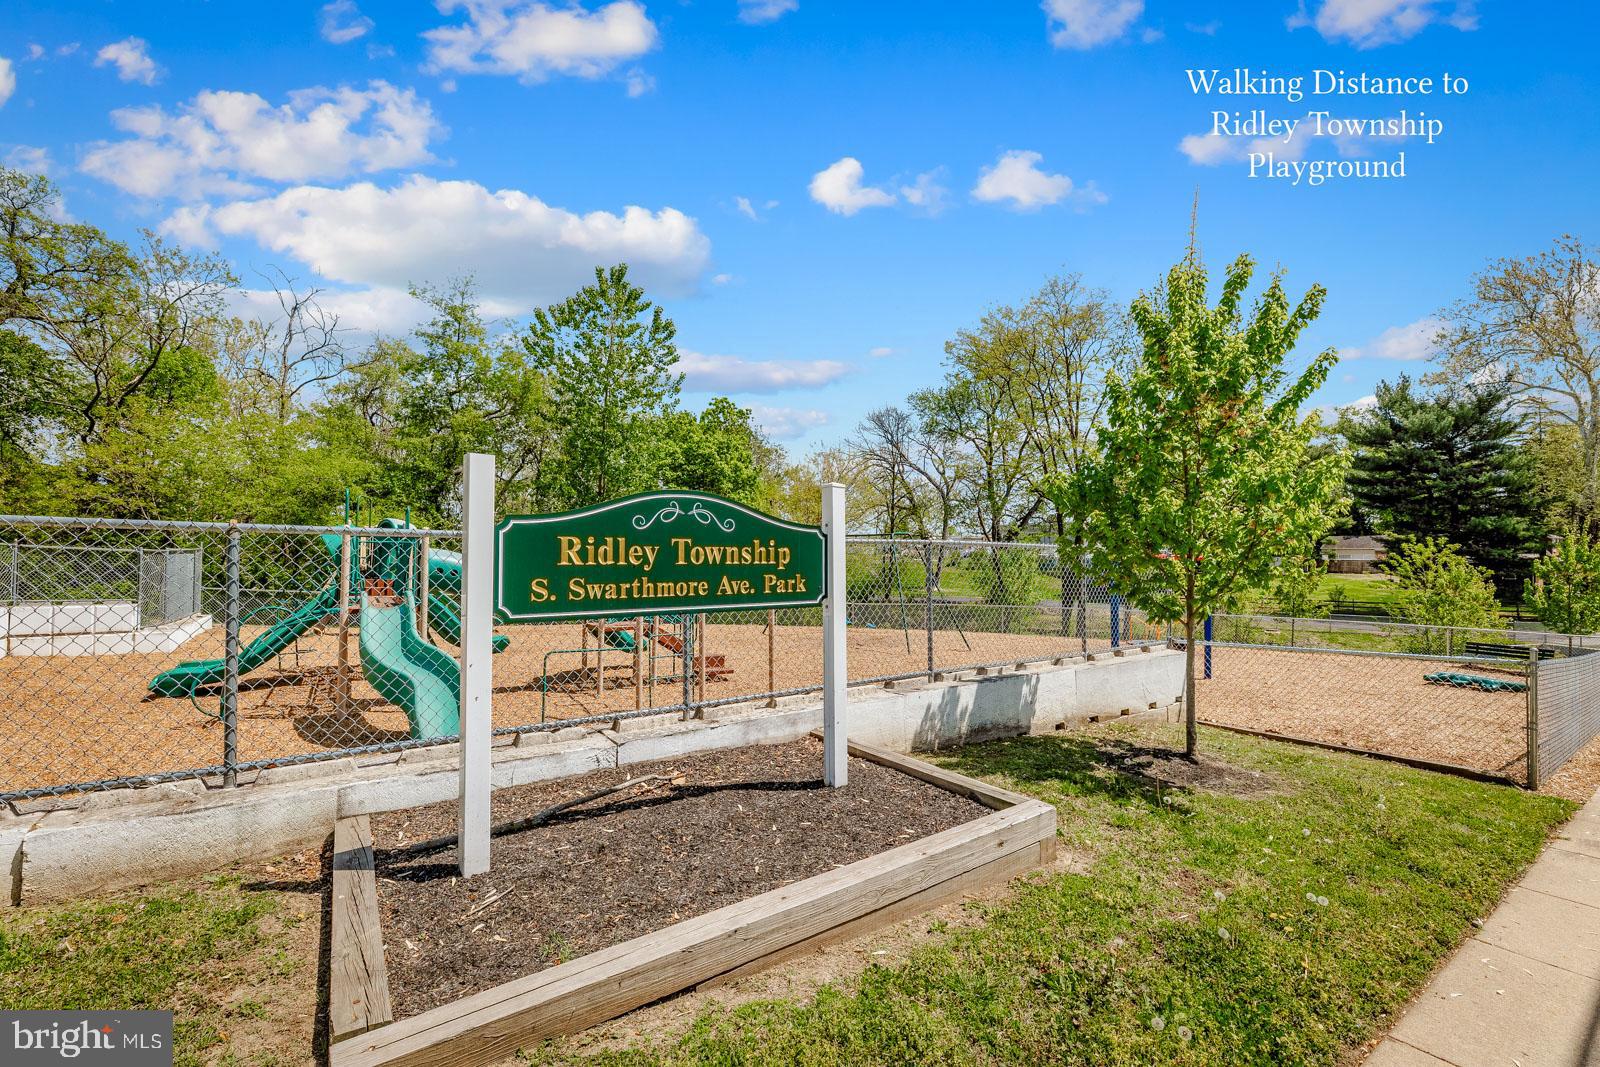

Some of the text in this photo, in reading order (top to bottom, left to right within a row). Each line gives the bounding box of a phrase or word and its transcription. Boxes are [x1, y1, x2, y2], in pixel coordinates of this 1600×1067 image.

[557, 535, 791, 571] Ridley Township
[530, 574, 807, 602] S. Swarthmore Ave. Park
